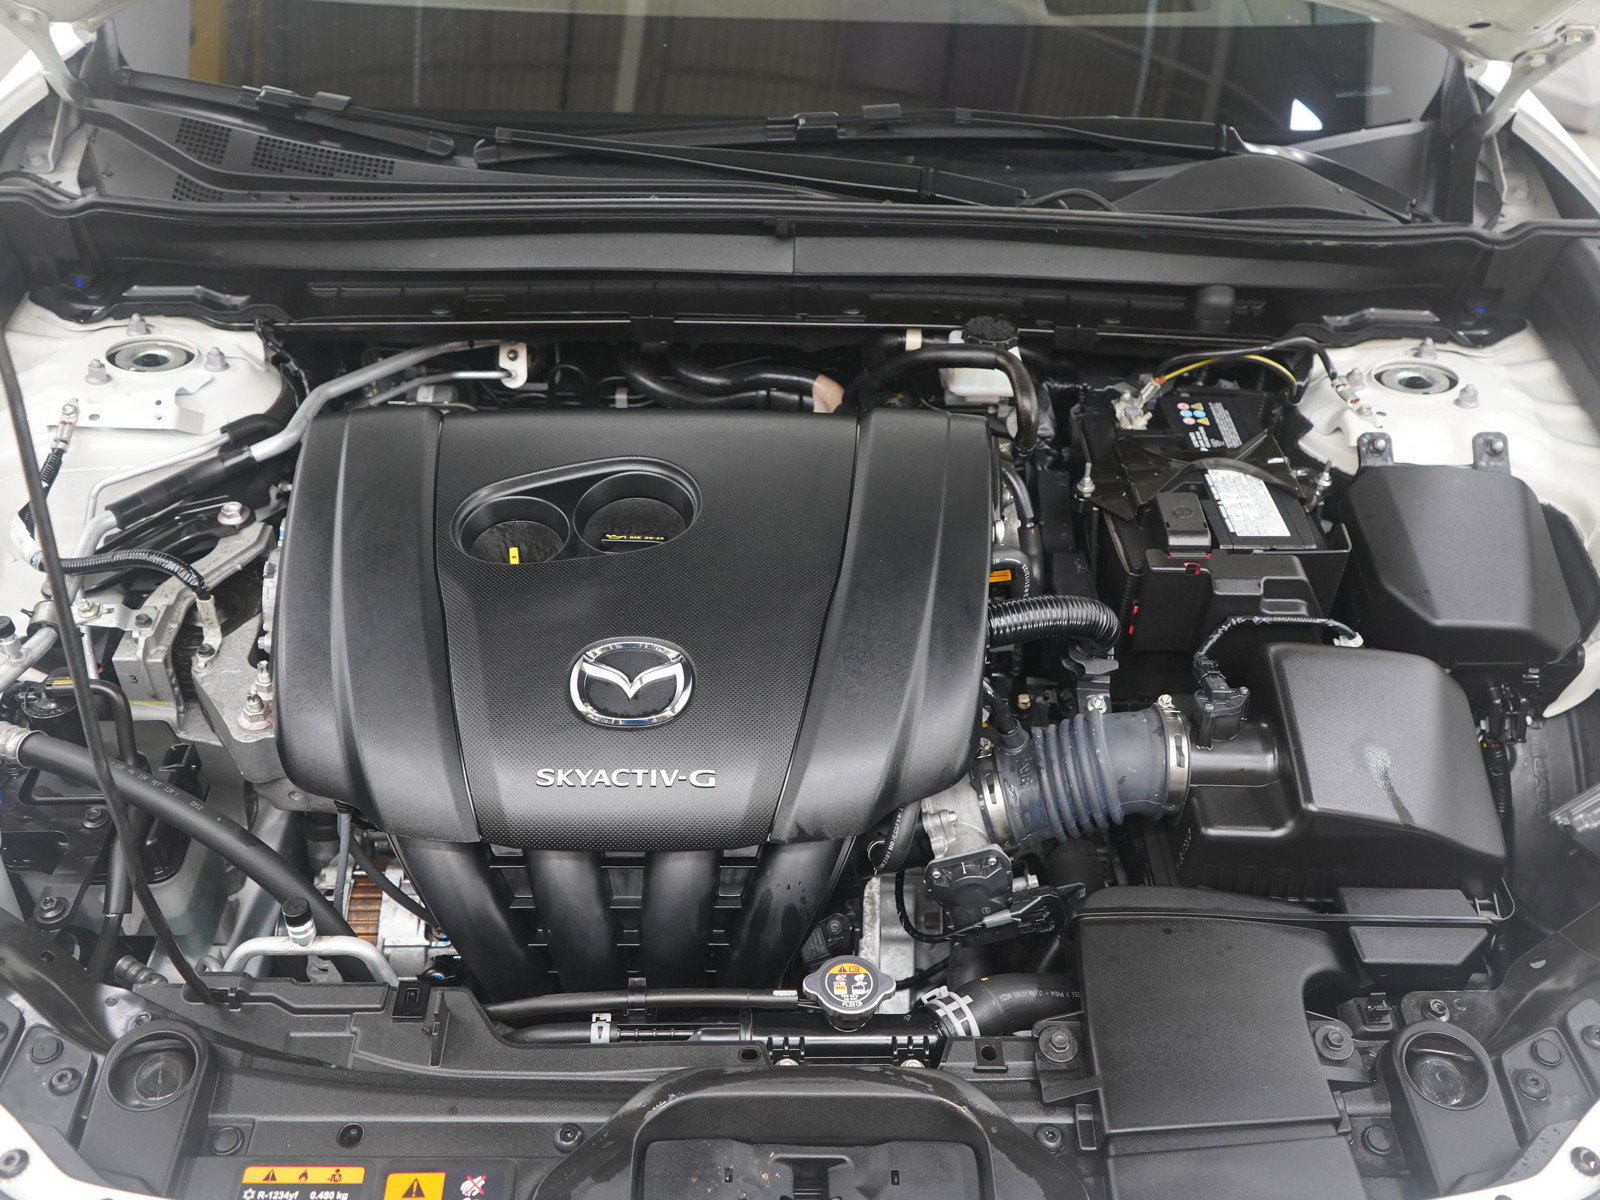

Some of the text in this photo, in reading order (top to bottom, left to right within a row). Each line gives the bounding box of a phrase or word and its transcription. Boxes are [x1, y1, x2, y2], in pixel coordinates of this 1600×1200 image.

[535, 768, 716, 788] SKYACTIV-G
[257, 1190, 348, 1200] R-1234yf 0.480 kg
